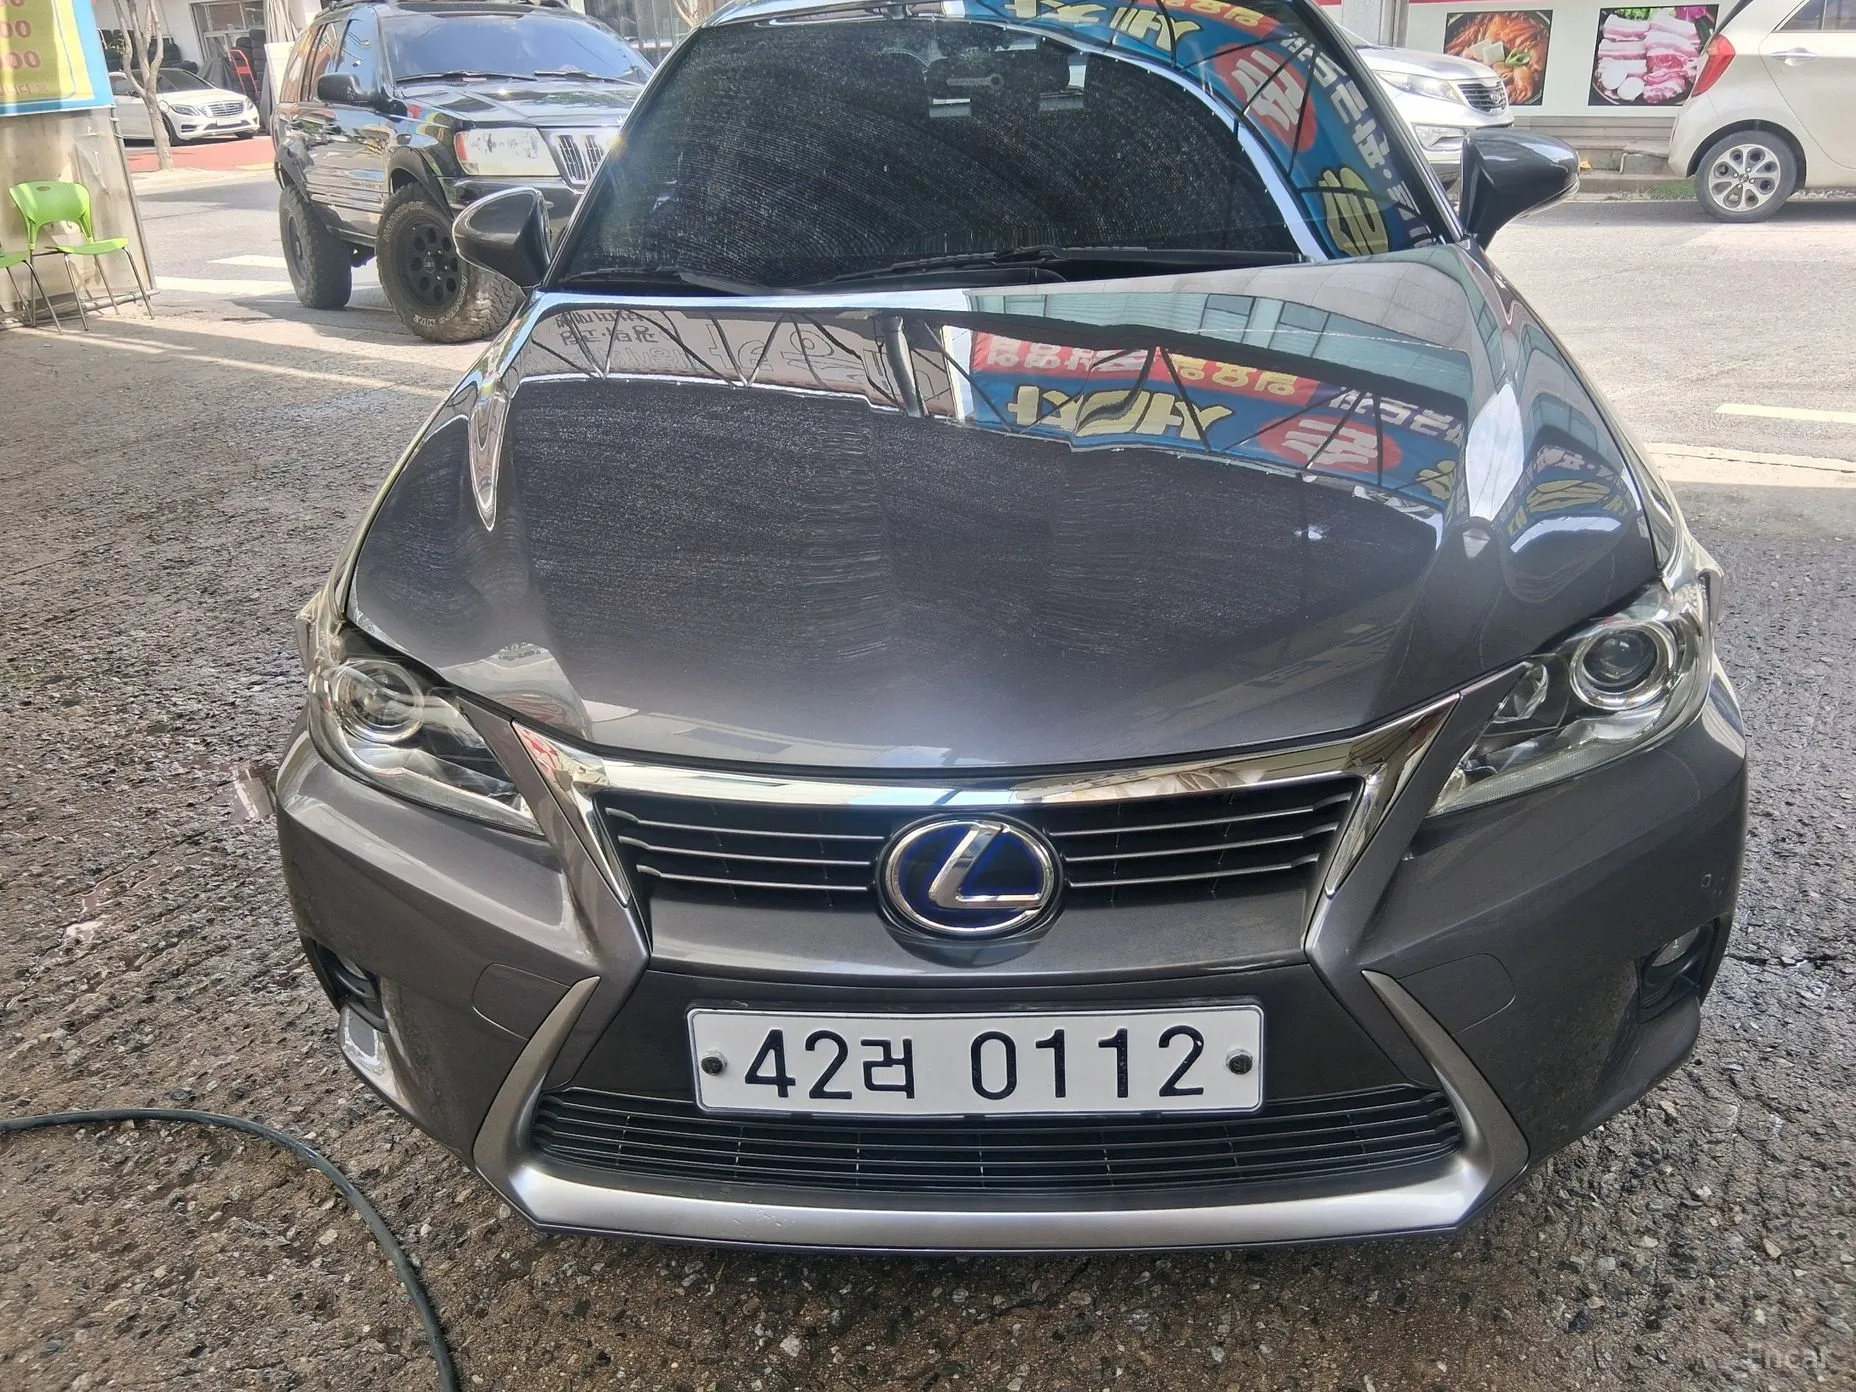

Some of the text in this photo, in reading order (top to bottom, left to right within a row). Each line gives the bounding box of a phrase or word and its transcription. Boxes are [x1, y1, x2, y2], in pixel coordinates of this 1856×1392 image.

[0, 51, 41, 69] 00
[744, 1025, 1205, 1101] 42러 0112
